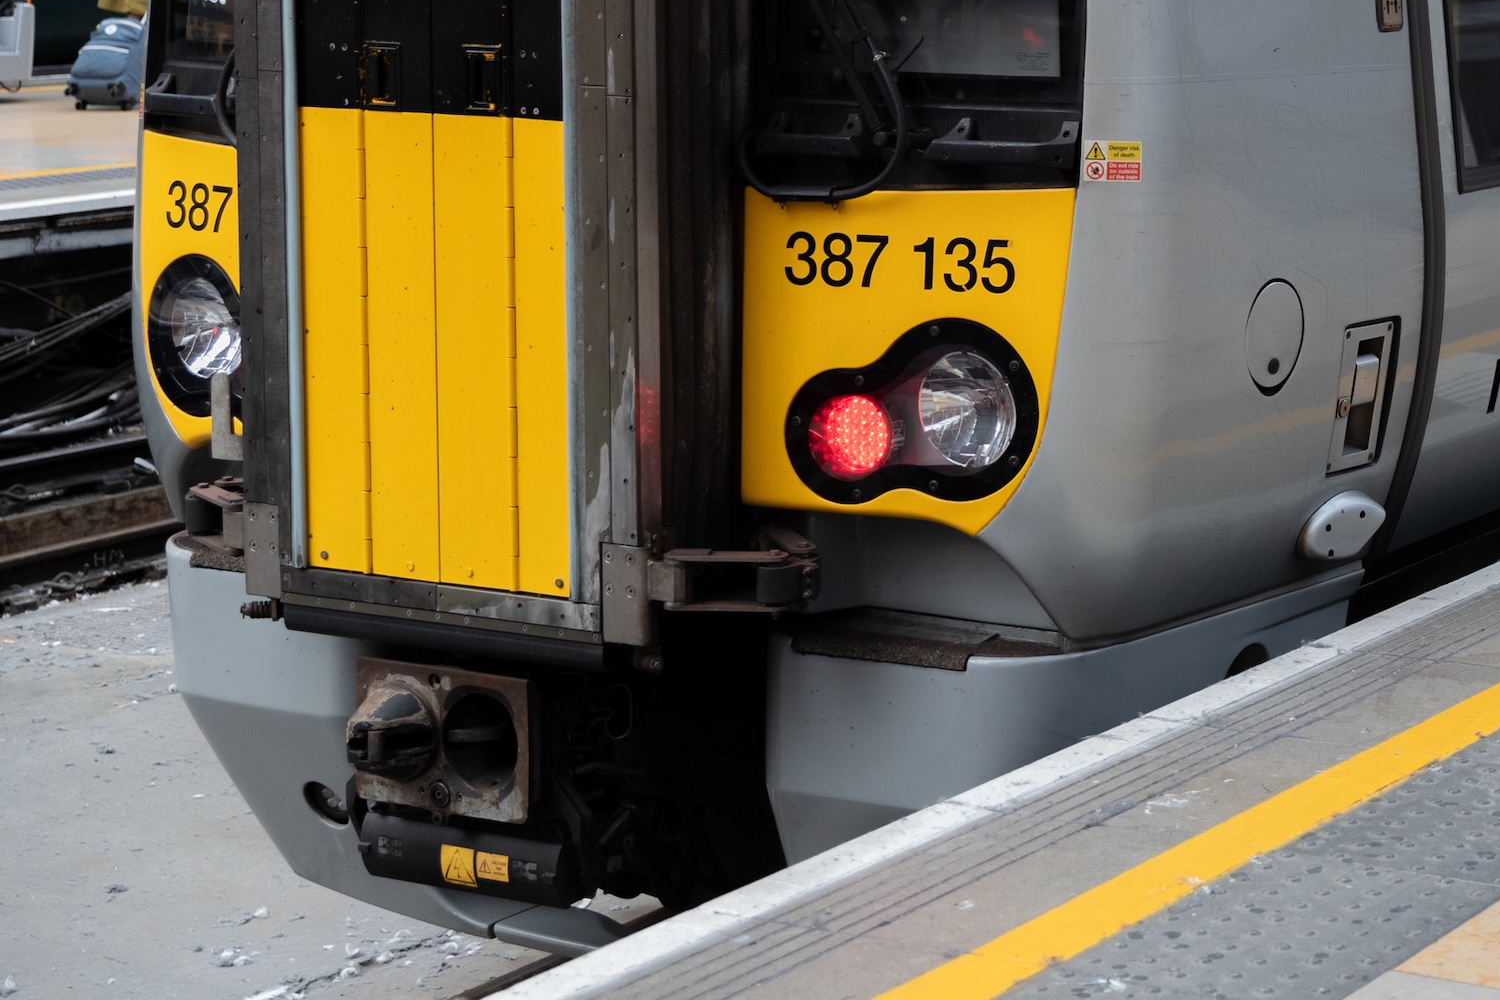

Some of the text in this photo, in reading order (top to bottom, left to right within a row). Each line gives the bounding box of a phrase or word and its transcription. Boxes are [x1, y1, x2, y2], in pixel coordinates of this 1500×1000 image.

[166, 180, 233, 233] 387
[784, 231, 1016, 294] 387 135
